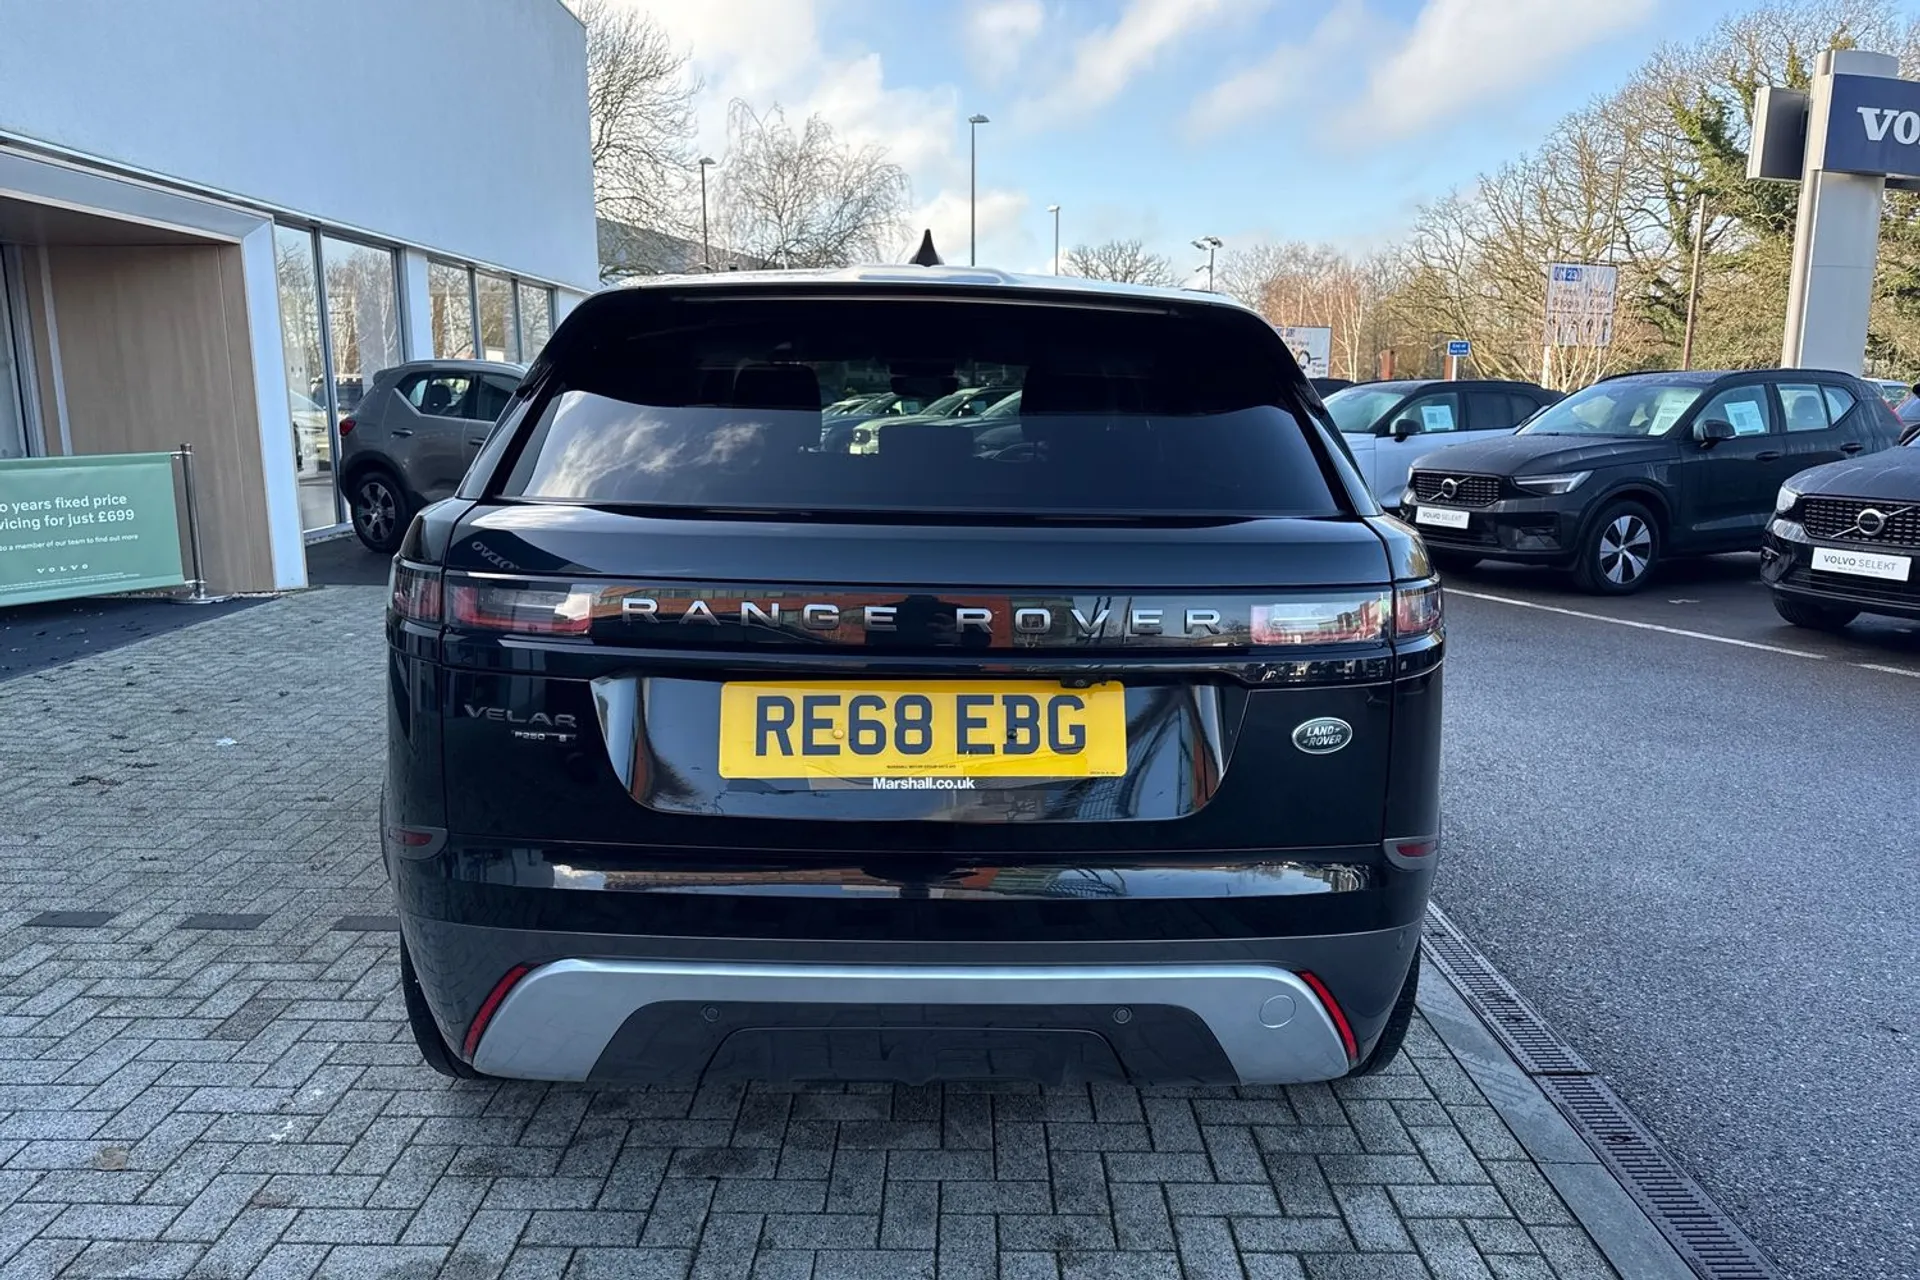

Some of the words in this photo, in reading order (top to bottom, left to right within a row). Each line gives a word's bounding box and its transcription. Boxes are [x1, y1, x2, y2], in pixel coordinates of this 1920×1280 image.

[1856, 106, 1920, 145] VO
[12, 500, 52, 514] years
[55, 496, 90, 509] fixed
[93, 494, 127, 509] price
[44, 514, 65, 527] for
[68, 512, 95, 528] just
[98, 509, 135, 522] £699
[15, 542, 45, 550] member
[95, 535, 108, 543] find
[36, 563, 89, 574] VOLVO
[1823, 554, 1856, 566] VOLVO
[1858, 558, 1897, 572] SELEKT
[622, 597, 898, 632] RANGE
[956, 608, 1222, 635] ROVER
[463, 703, 577, 728] VELAR
[755, 694, 933, 757] RE68
[956, 694, 1086, 756] EBG
[1308, 734, 1342, 746] ROVER
[872, 776, 976, 790] Marshall.co.uk
